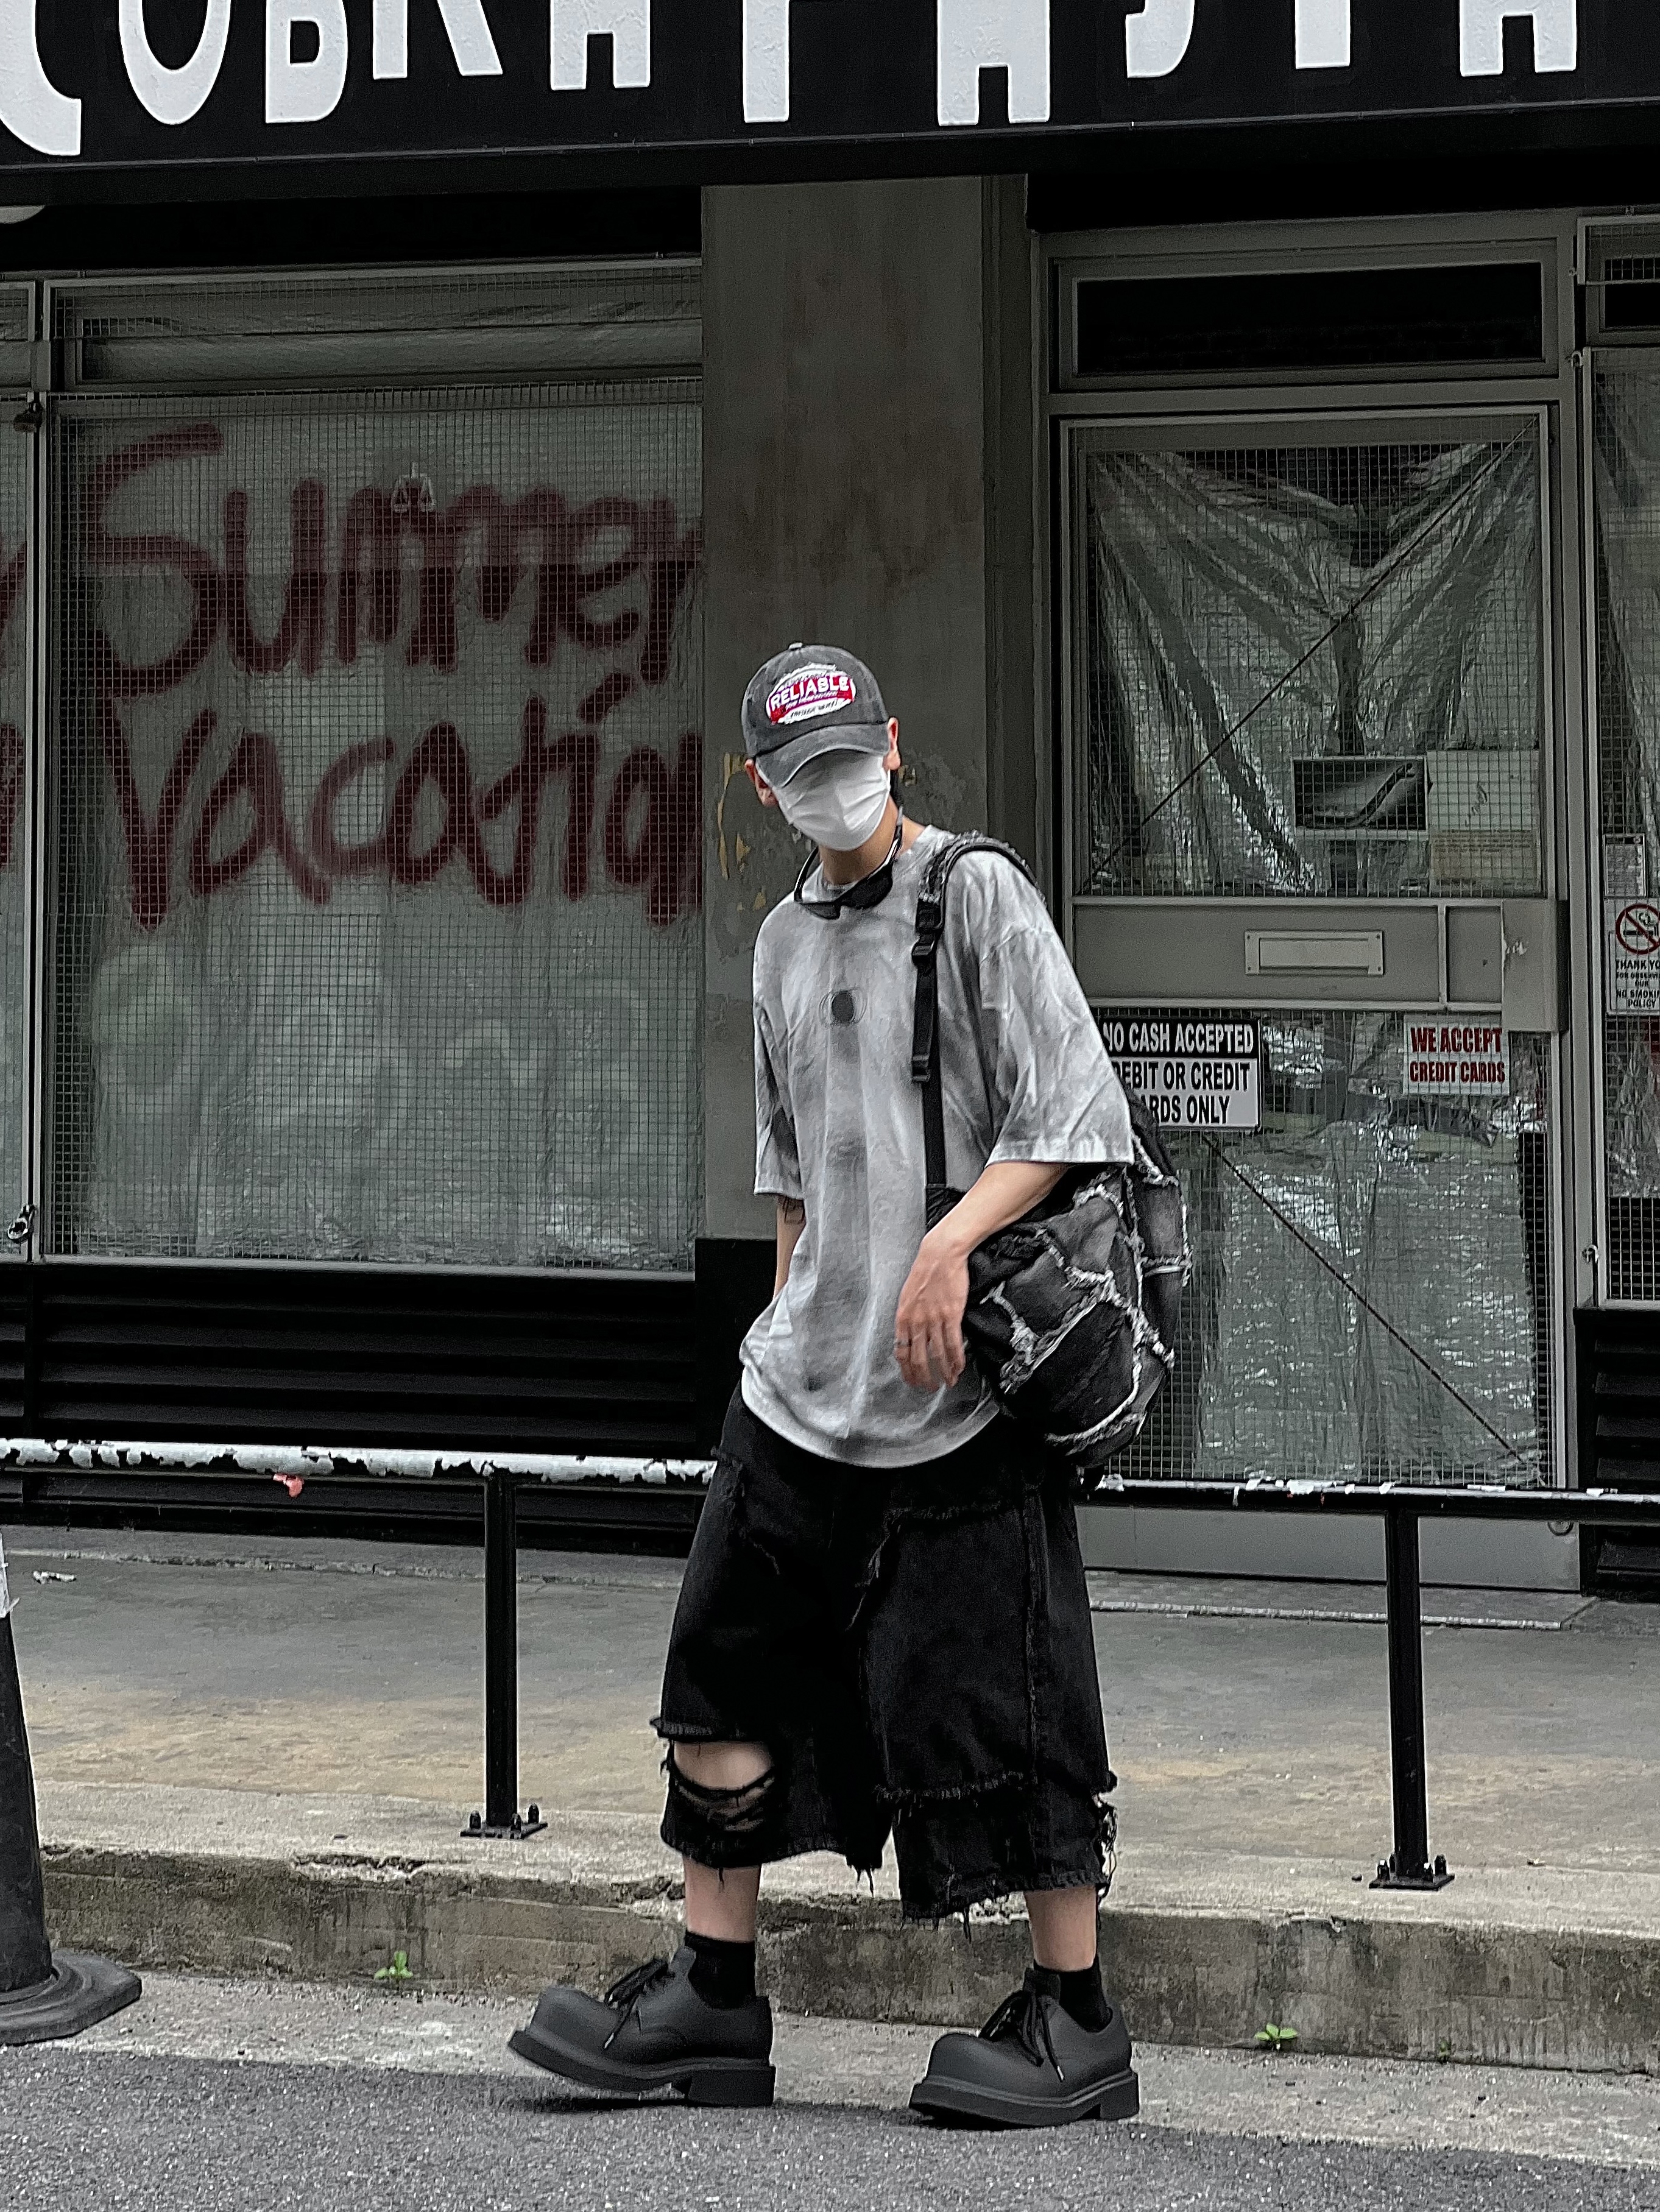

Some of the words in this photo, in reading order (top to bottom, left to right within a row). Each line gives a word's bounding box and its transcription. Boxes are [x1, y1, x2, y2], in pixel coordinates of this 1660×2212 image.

[84, 422, 702, 694] Summer
[770, 672, 850, 712] RELIABLE
[1616, 959, 1647, 970] THANK
[1628, 999, 1656, 1008] POLICY
[1103, 1022, 1124, 1052] NO
[1129, 1022, 1170, 1053] CASH
[1174, 1023, 1254, 1053] ACCEPTED
[1410, 1027, 1436, 1052] WE
[1440, 1027, 1502, 1052] ACCEPT
[1163, 1061, 1186, 1090] OR
[1191, 1062, 1250, 1091] CREDIT
[1410, 1061, 1457, 1083] CREDIT
[1461, 1061, 1505, 1083] CARDS
[1187, 1095, 1230, 1124] ONLY
